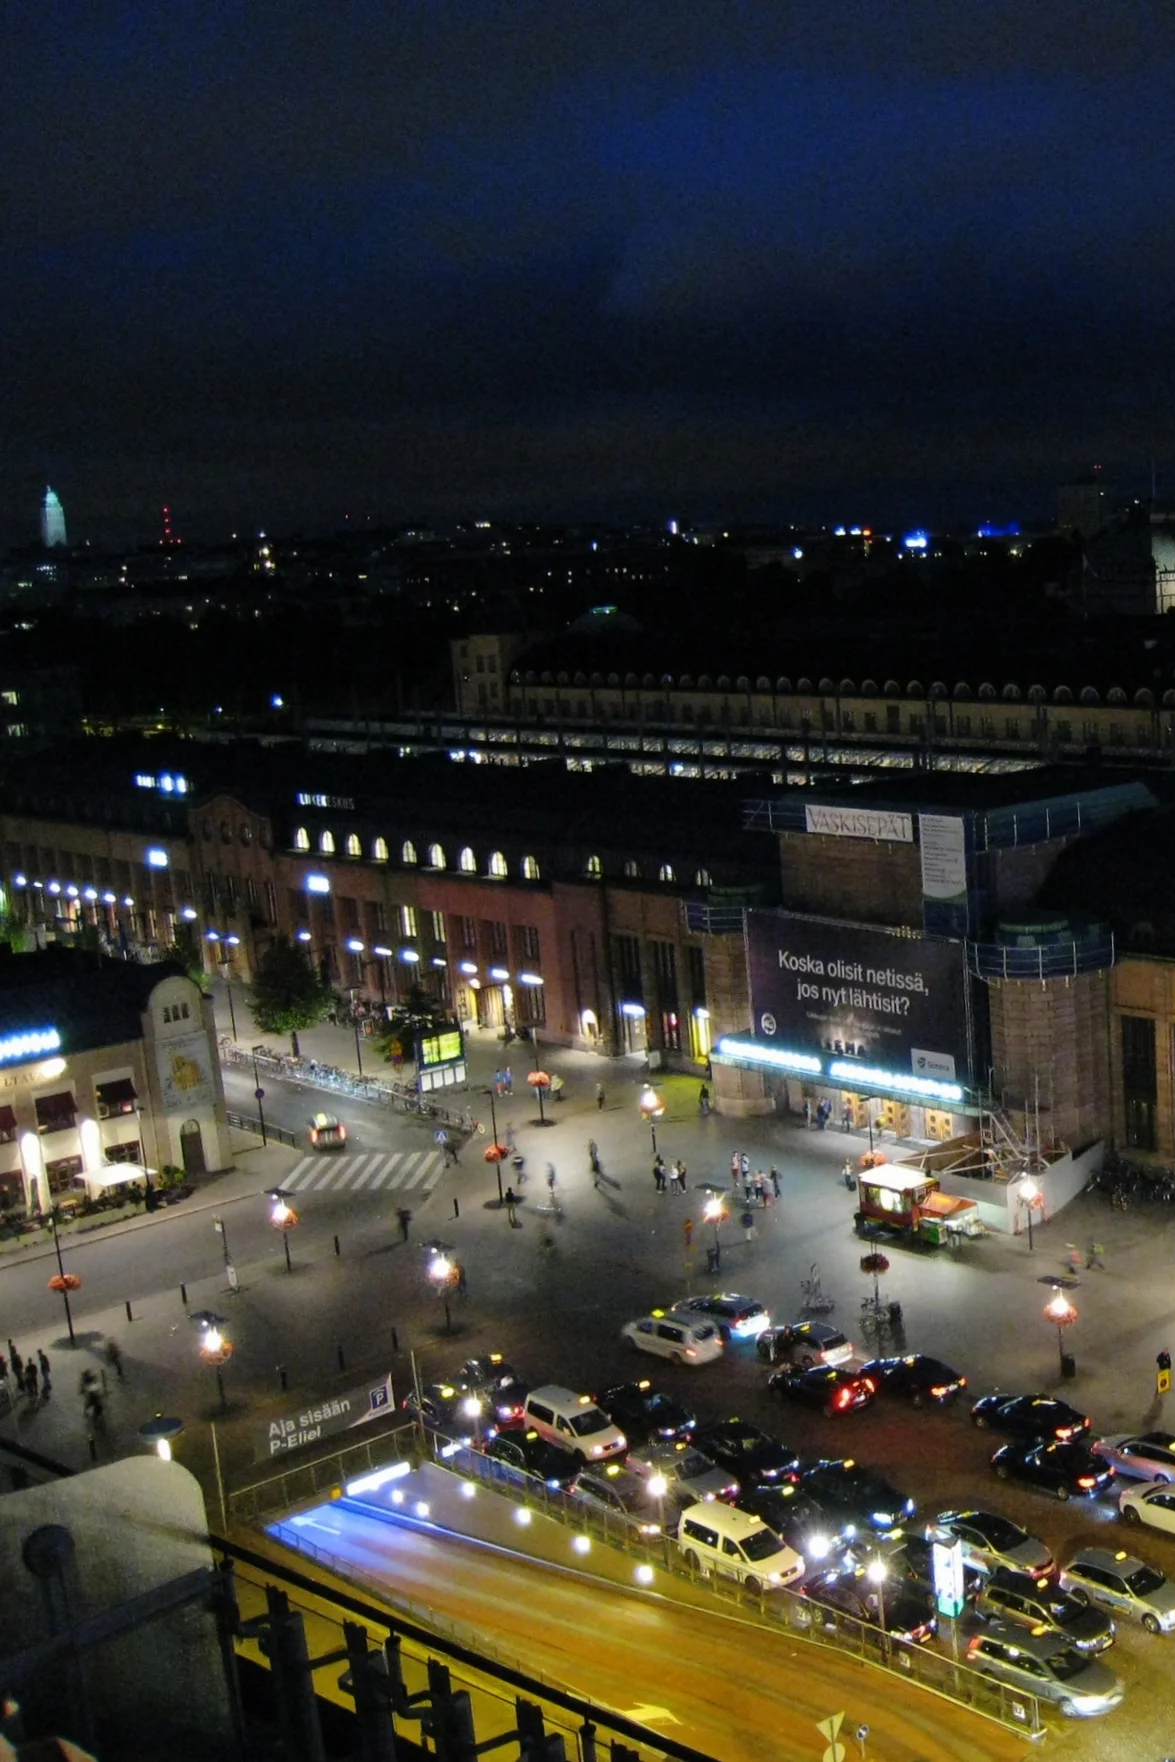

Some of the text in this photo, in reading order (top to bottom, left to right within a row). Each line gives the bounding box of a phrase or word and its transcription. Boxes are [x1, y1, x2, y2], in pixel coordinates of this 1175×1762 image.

[806, 807, 909, 839] VASKISEPÄT
[778, 949, 930, 996] Koska olisit netissä,
[797, 979, 819, 1000] jos
[822, 986, 847, 1007] nyt
[849, 987, 910, 1016] lähtisit?
[268, 1418, 296, 1438] Aja
[300, 1399, 351, 1427] sisään
[270, 1425, 321, 1455] P-Eliel
